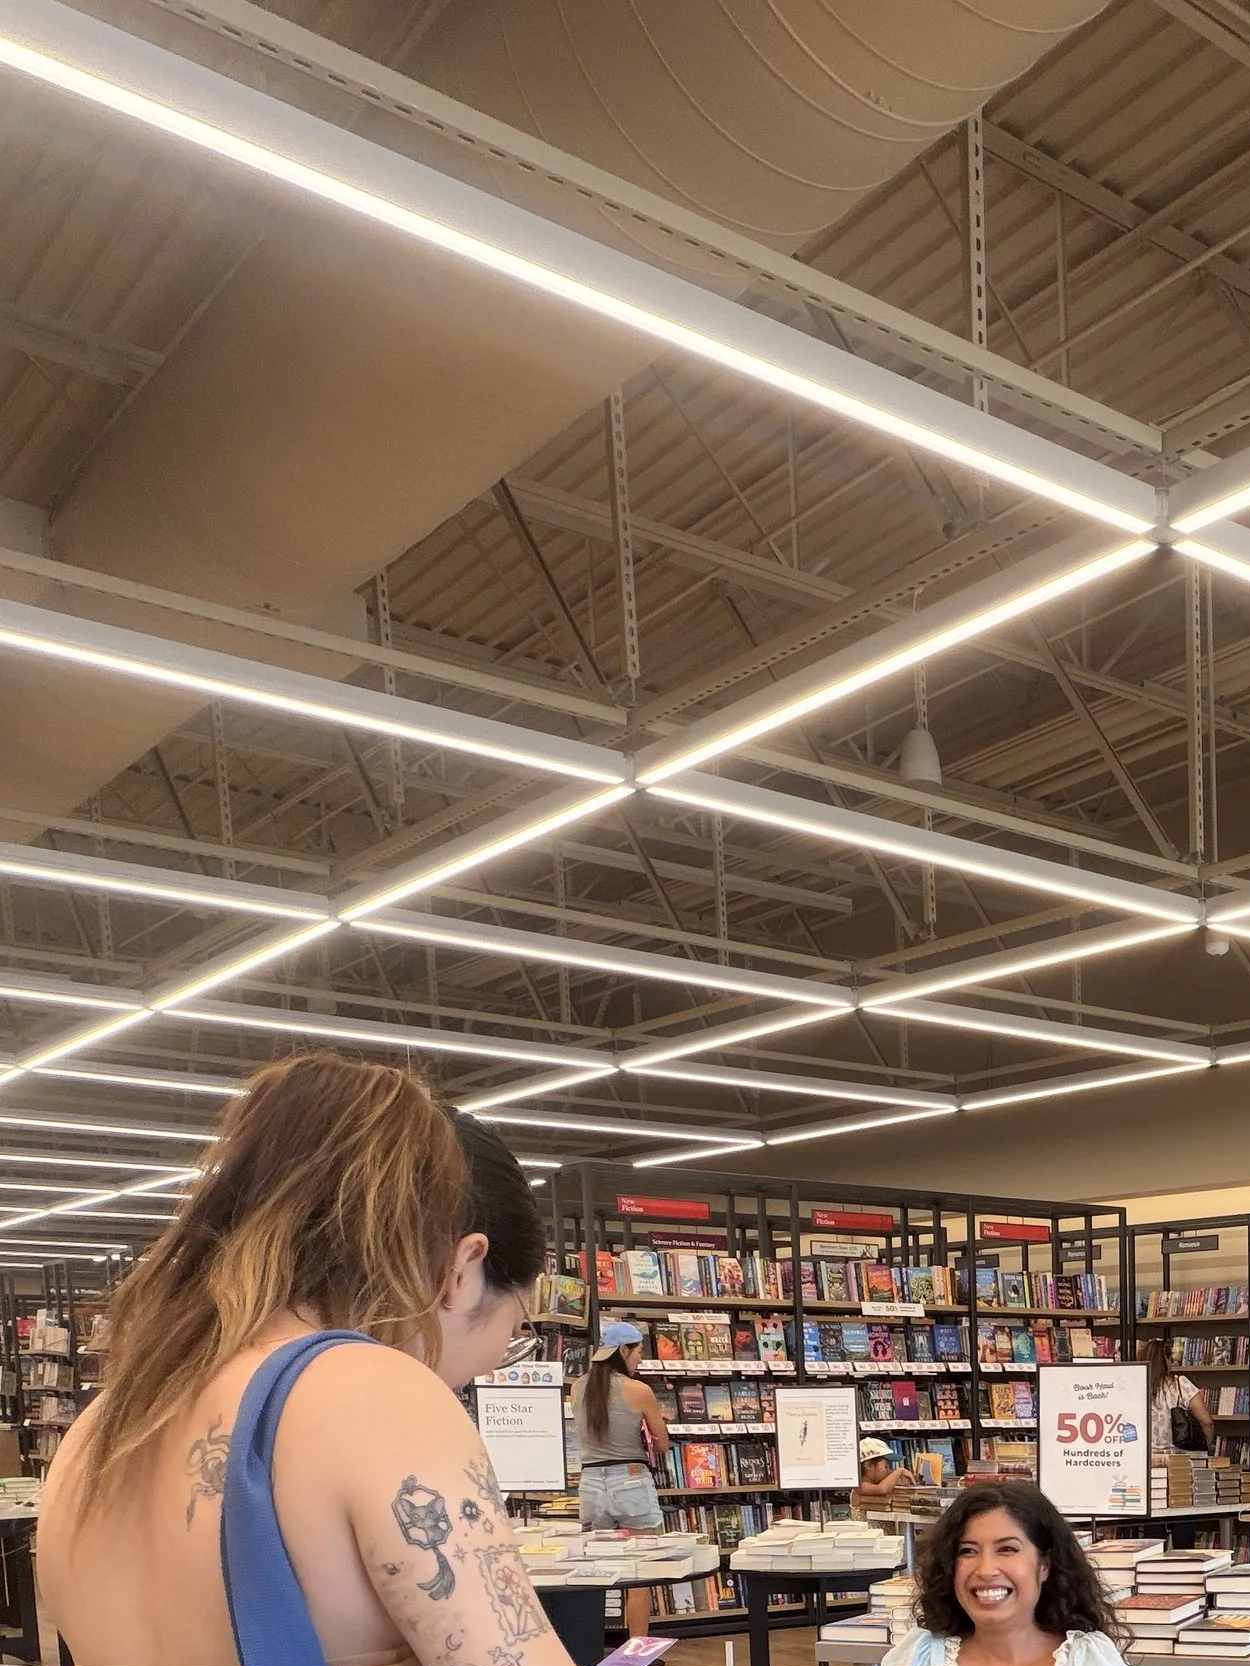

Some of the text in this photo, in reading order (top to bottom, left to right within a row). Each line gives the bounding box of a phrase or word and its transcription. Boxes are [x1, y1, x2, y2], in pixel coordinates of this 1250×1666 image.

[1178, 1241, 1201, 1249] Romance
[1073, 1382, 1114, 1392] Book Haul
[1086, 1391, 1109, 1400] Back!
[485, 1403, 533, 1413] Five Star
[486, 1415, 523, 1426] Fiction
[1056, 1412, 1125, 1444] 50%
[1063, 1449, 1124, 1458] Hundreds of
[1065, 1459, 1121, 1467] Hardcovers
